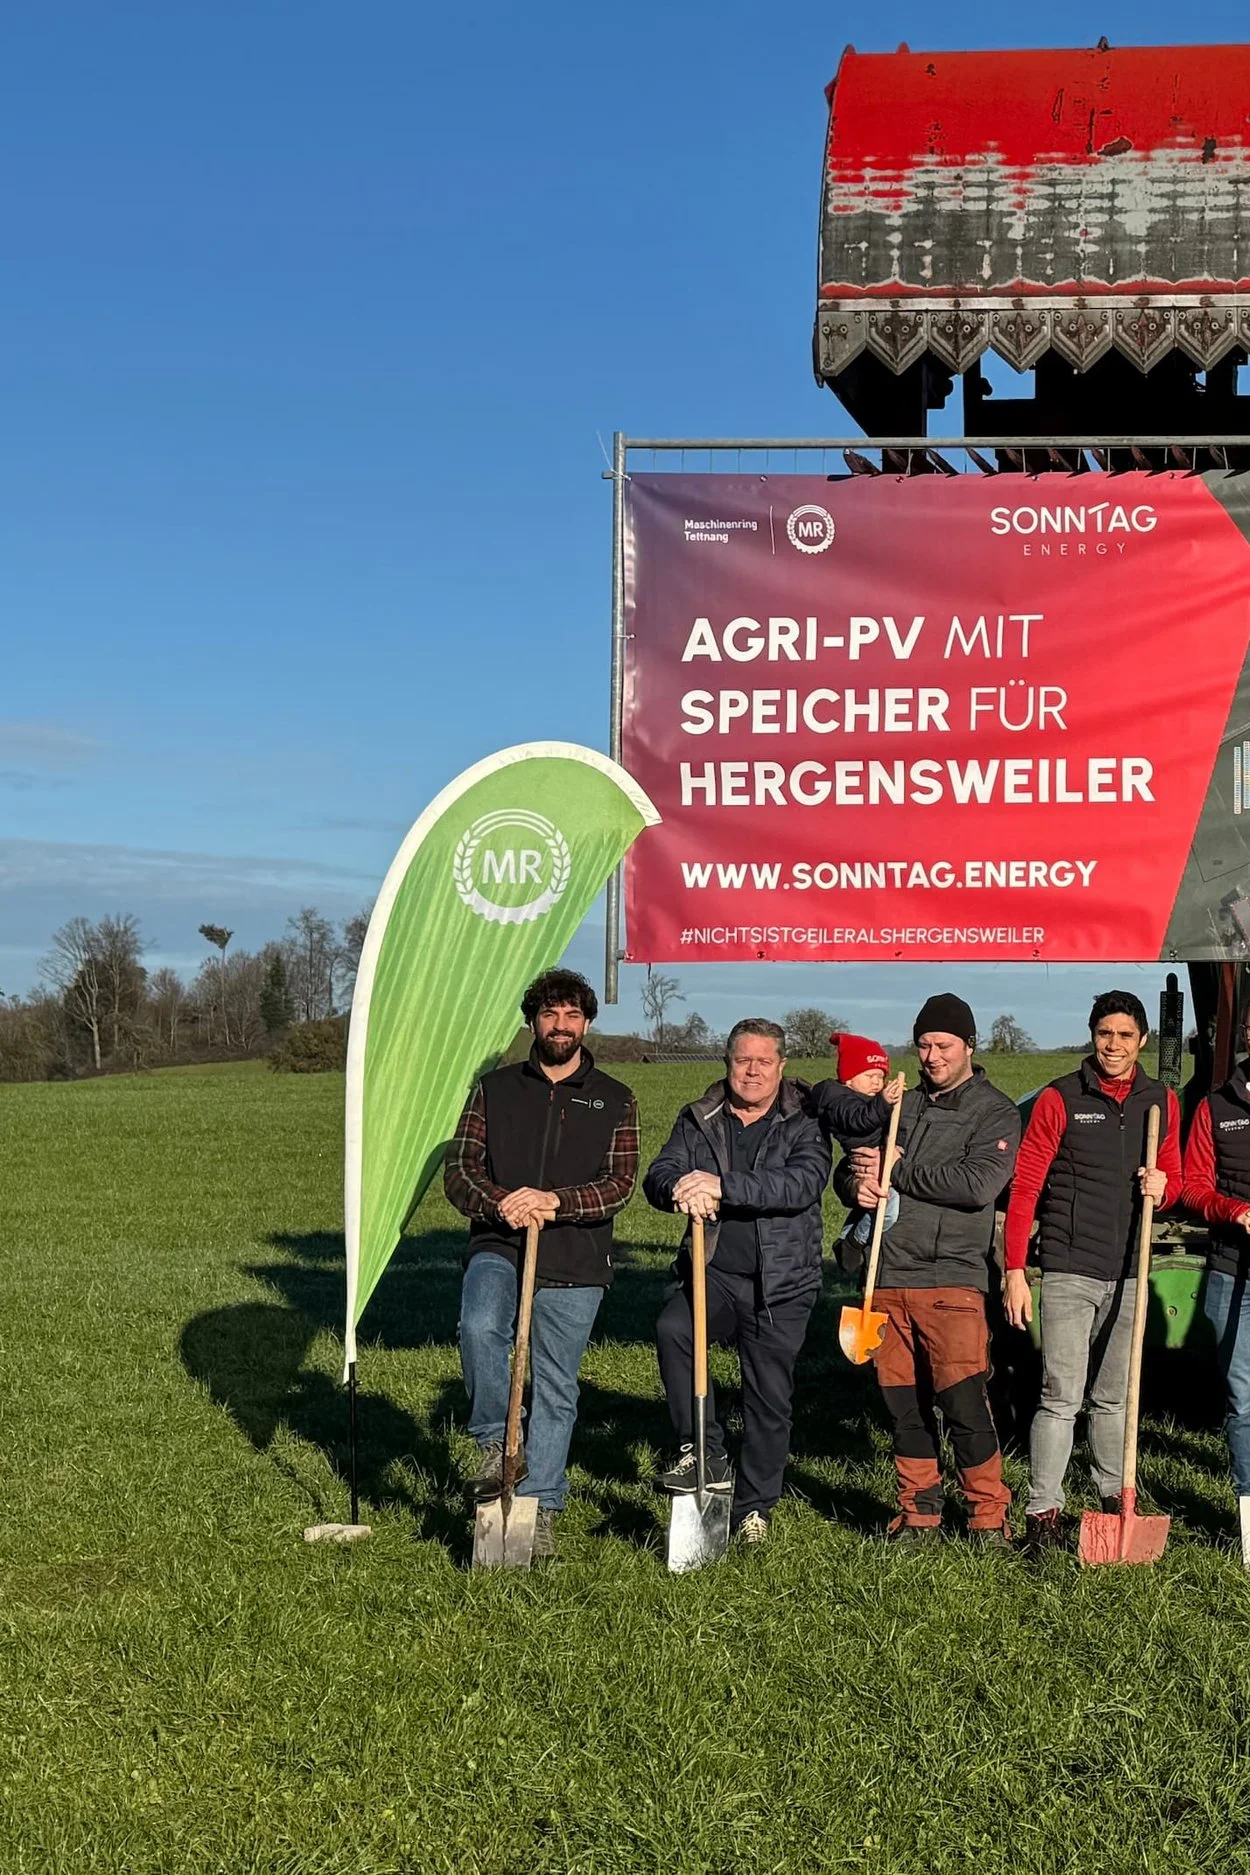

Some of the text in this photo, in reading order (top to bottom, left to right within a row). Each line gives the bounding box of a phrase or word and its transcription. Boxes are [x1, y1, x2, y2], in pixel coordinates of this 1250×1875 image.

[684, 519, 758, 532] Maschinenring
[798, 521, 824, 538] MR
[990, 502, 1158, 535] SONNTAG
[684, 531, 729, 543] Tettnang
[1023, 543, 1126, 556] ENERGY
[681, 614, 1044, 662] AGRI-PV MIT
[680, 680, 1068, 735] SPEICHER FÜR
[680, 757, 1156, 806] HERGENSWEILER
[482, 849, 543, 885] MR
[680, 860, 1097, 890] WWW.SONNTAG.ENERGY
[680, 926, 1045, 945] #NICHTSISTGEILERALSHERGENSWEILER
